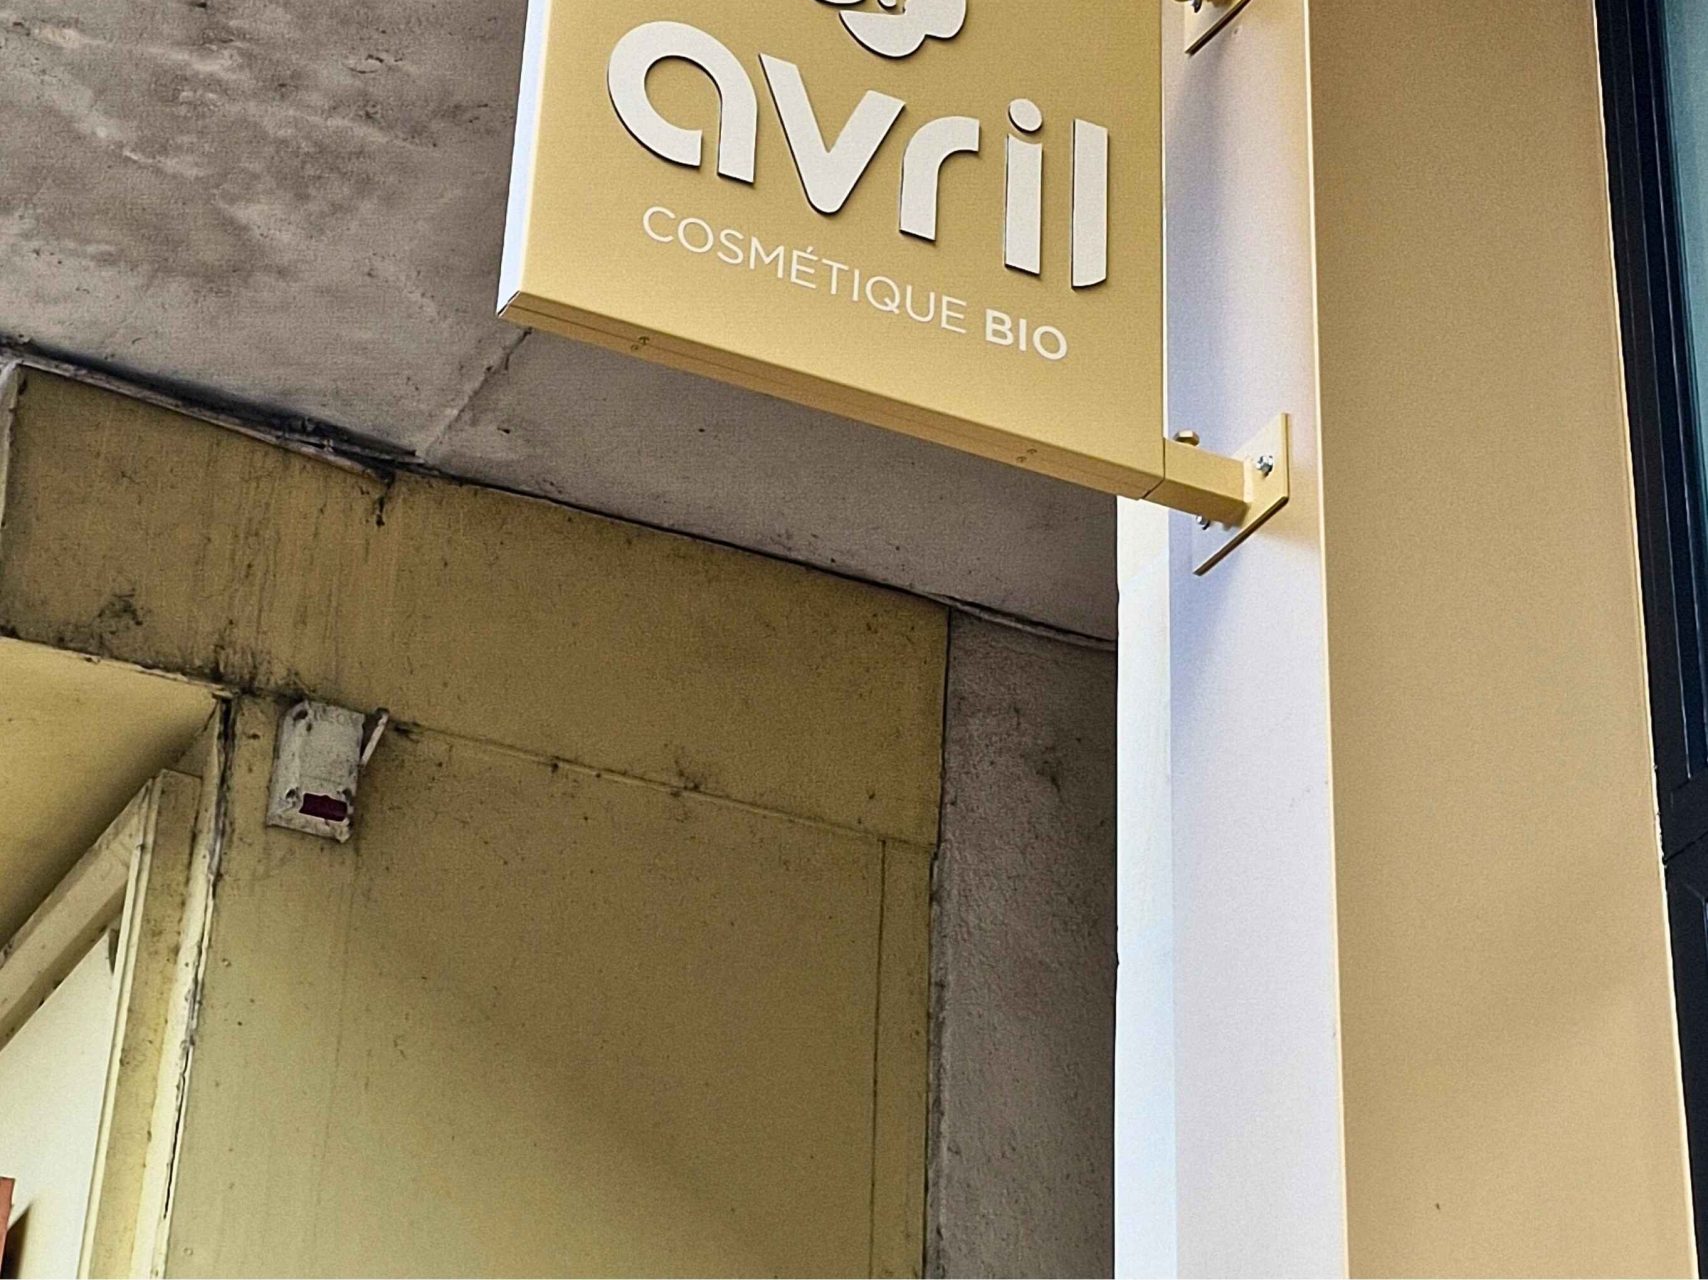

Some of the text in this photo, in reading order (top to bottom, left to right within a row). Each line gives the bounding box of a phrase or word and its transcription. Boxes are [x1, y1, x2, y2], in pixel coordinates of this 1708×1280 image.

[608, 21, 1108, 289] avril
[642, 206, 1068, 361] COSMÉTIQUE BIO
